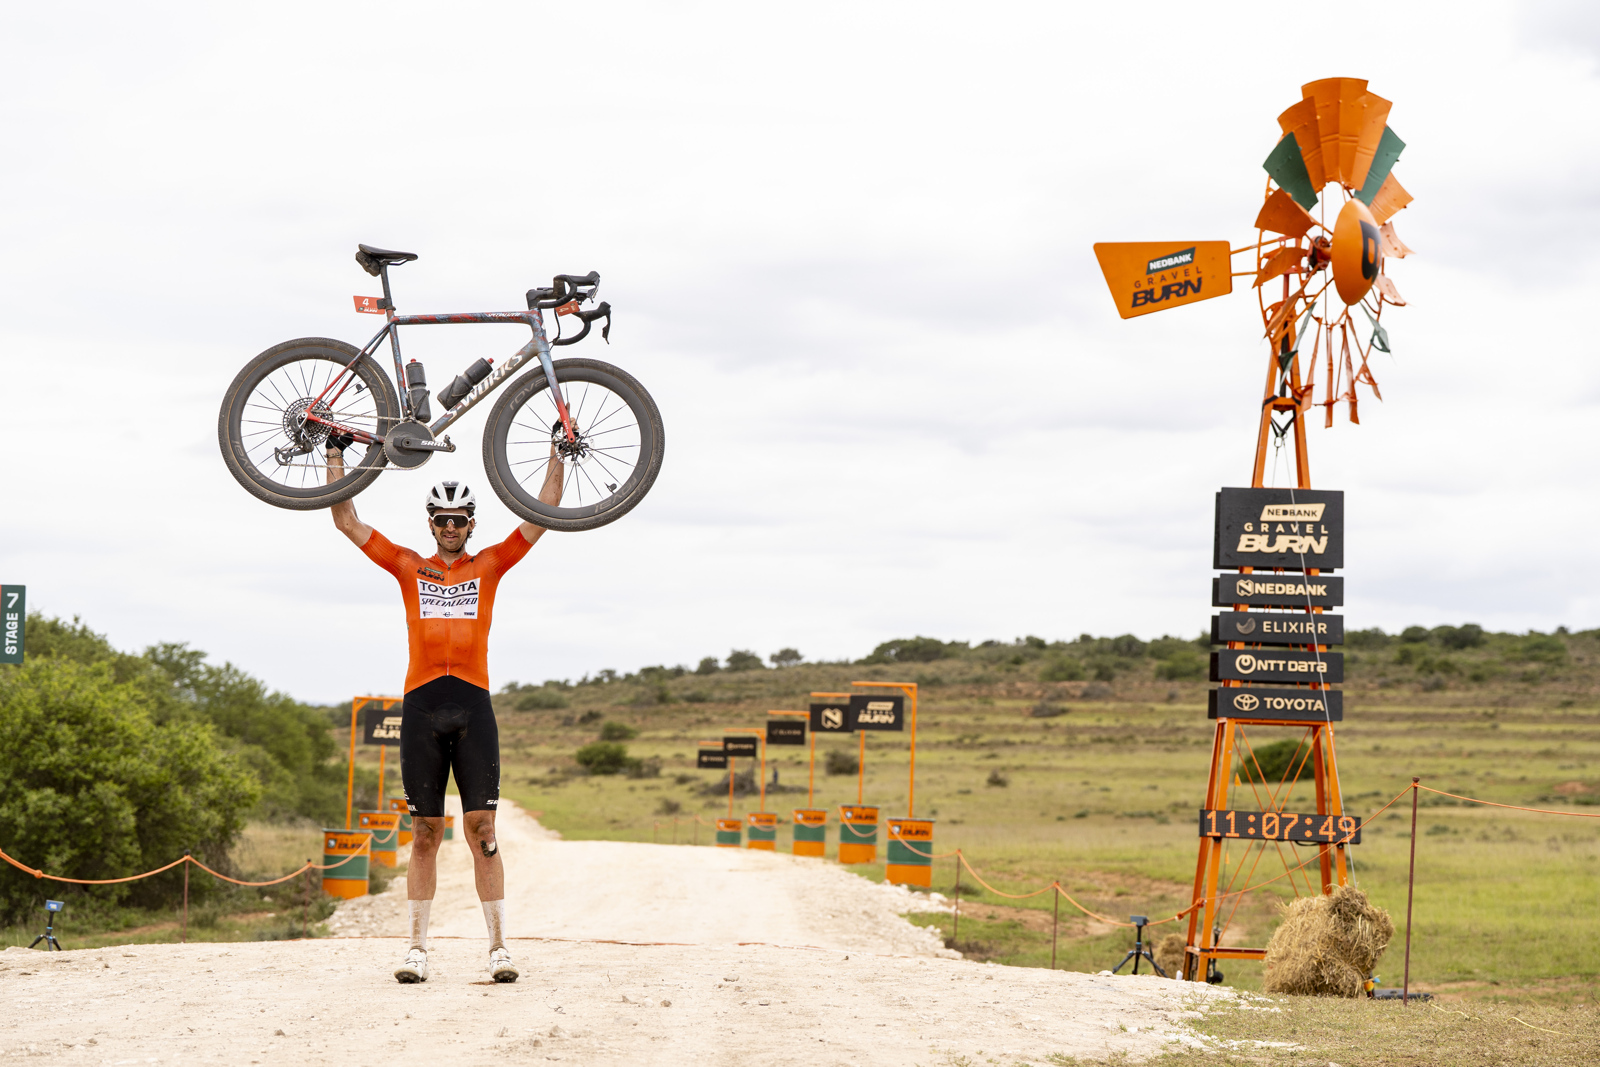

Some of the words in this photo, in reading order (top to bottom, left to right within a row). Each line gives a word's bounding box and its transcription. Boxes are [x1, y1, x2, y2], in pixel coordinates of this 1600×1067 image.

[1149, 252, 1192, 270] NEDBANK
[1134, 266, 1202, 288] GRAVEL
[1131, 277, 1202, 308] BURN
[362, 298, 369, 306] 4
[1267, 508, 1318, 517] NEDBANK
[1243, 522, 1328, 534] GRAVEL
[1236, 533, 1329, 554] BURN
[419, 581, 477, 595] TOYOTA
[1254, 583, 1328, 596] NEDBANK
[6, 592, 19, 608] 7
[421, 597, 478, 607] SPECIALIZED
[4, 613, 19, 655] STAGE
[1262, 621, 1328, 634] ELIXIRR
[1257, 659, 1286, 671] NTT
[1263, 697, 1325, 711] TOYOTA
[1206, 810, 1356, 843] 11:07:49
